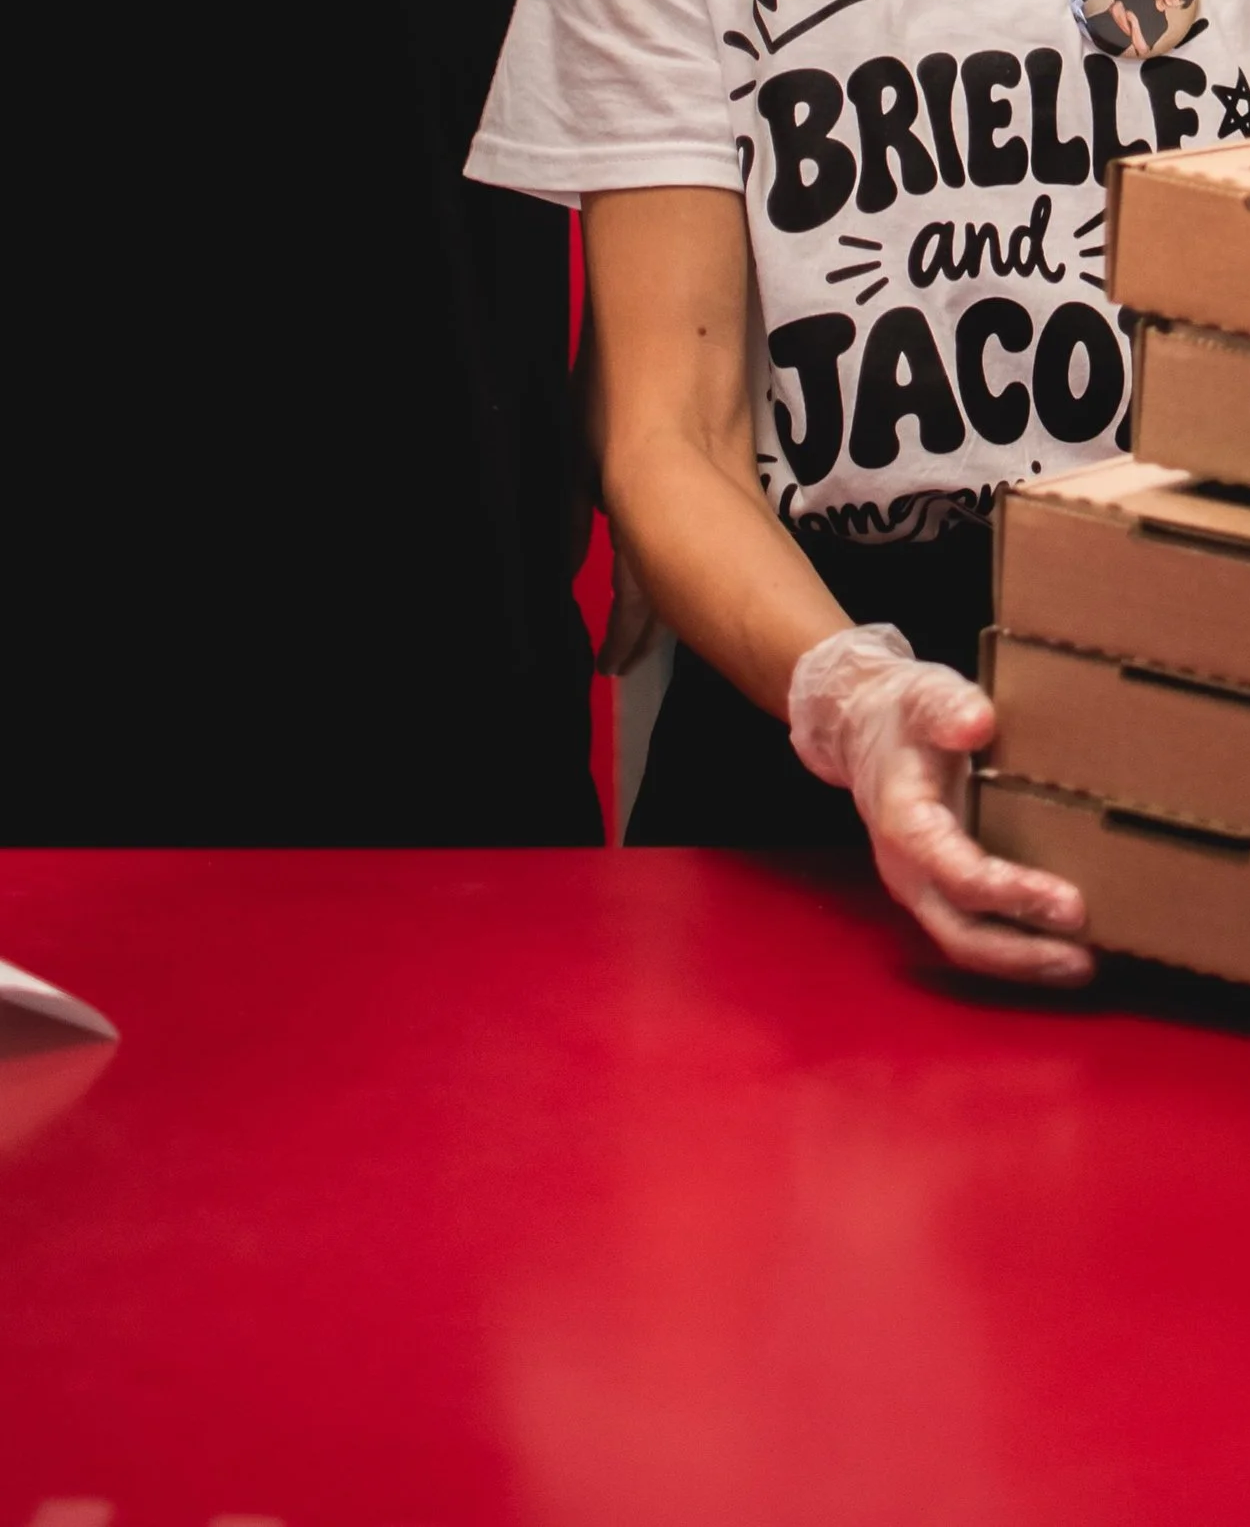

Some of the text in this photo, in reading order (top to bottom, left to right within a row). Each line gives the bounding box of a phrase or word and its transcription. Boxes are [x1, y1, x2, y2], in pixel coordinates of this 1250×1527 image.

[757, 47, 1208, 233] BRIELLE
[908, 193, 1067, 289] and
[767, 296, 1134, 487] JACO
